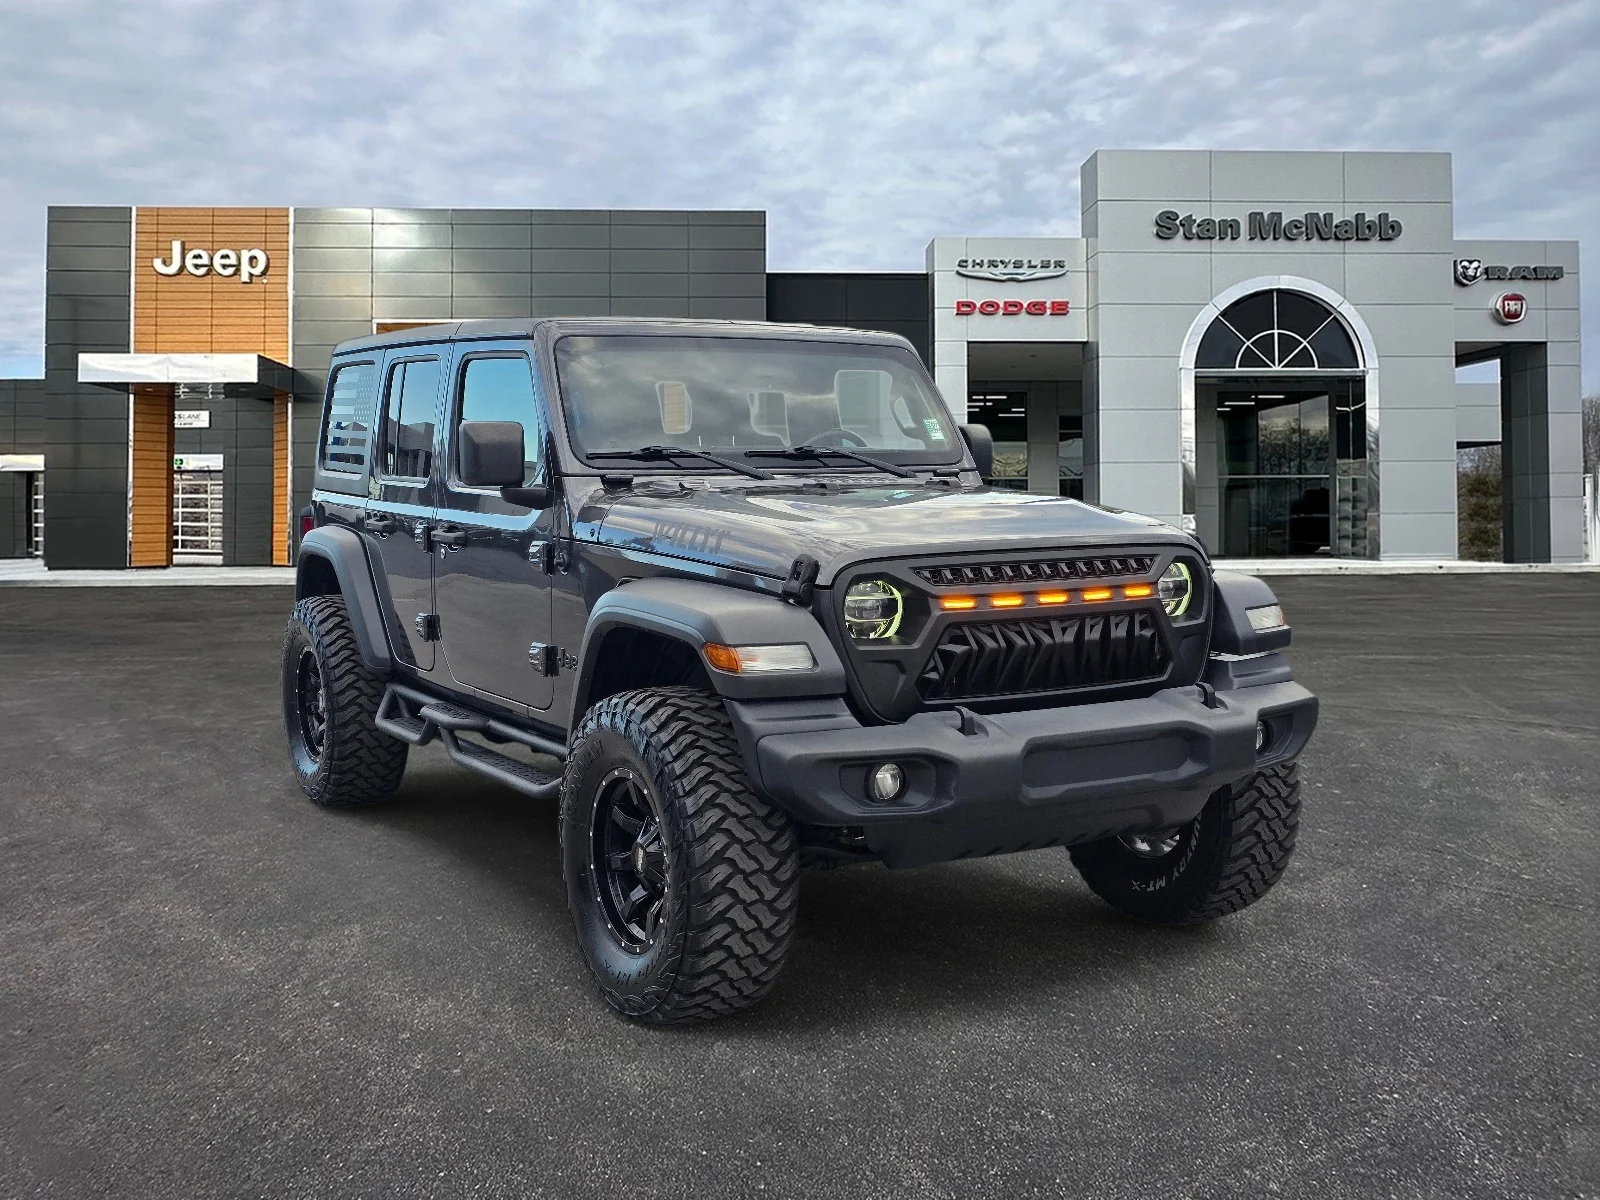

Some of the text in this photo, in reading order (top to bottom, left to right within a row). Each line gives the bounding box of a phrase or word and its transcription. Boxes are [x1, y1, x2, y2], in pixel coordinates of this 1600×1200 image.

[1155, 210, 1403, 242] Stan McNabb
[152, 239, 269, 284] Jeep
[957, 258, 1067, 269] CHRYSLER
[1484, 265, 1564, 280] RAM
[955, 300, 1070, 316] DODGE
